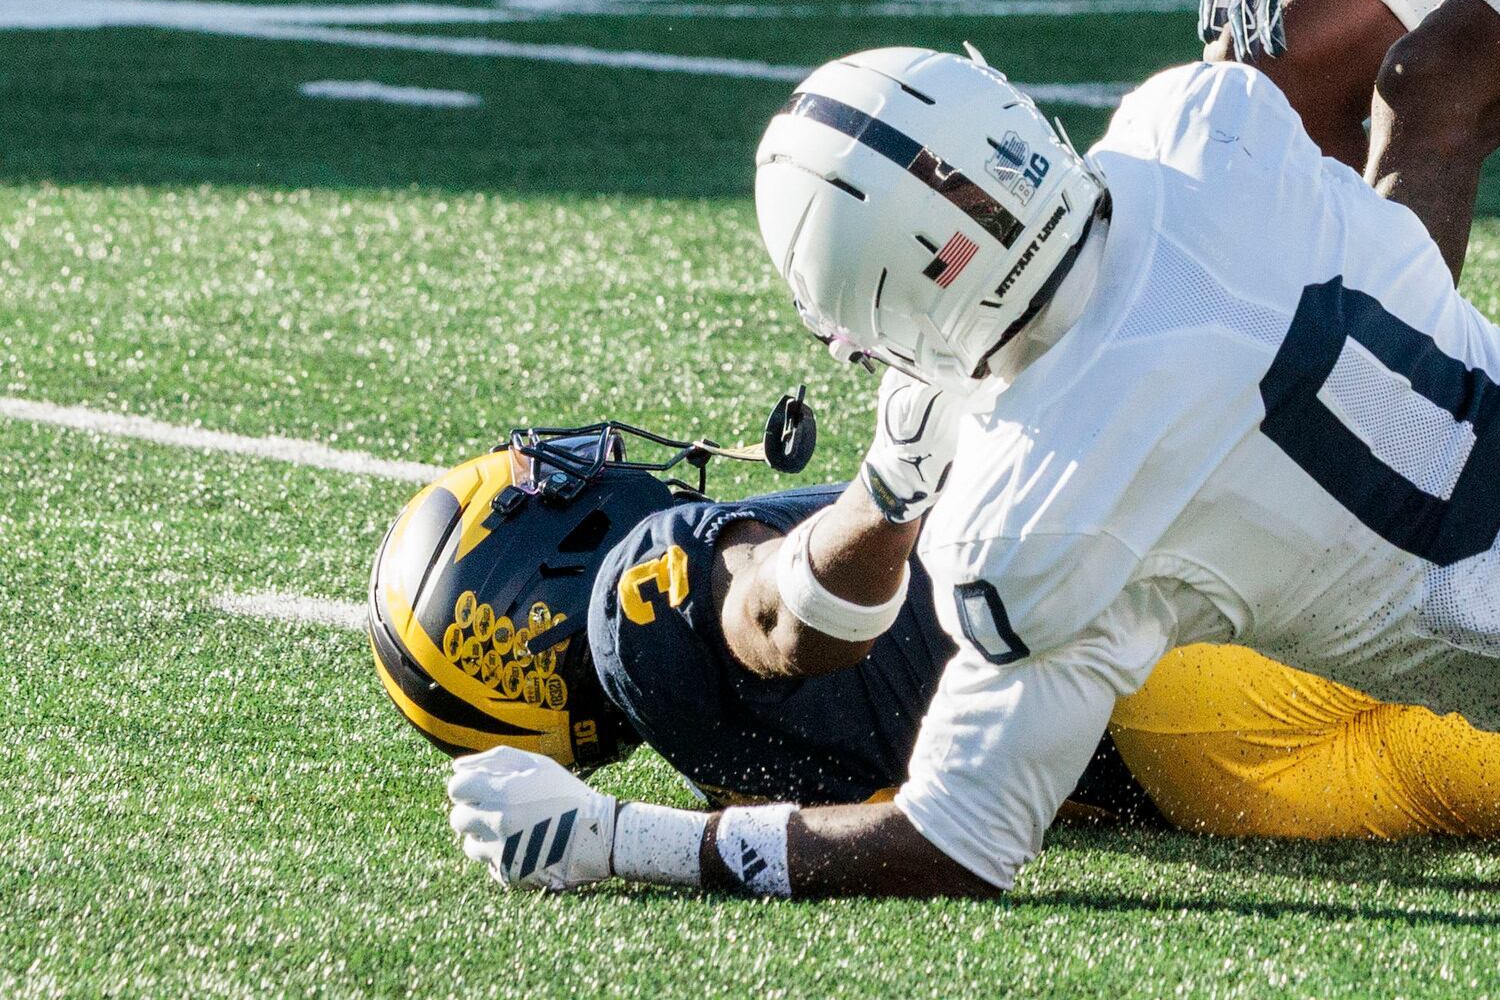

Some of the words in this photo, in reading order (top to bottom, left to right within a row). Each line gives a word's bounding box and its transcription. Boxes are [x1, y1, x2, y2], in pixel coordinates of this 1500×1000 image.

[994, 240, 1040, 298] NITTANY
[1037, 206, 1066, 243] LIONS
[953, 579, 1031, 666] 0
